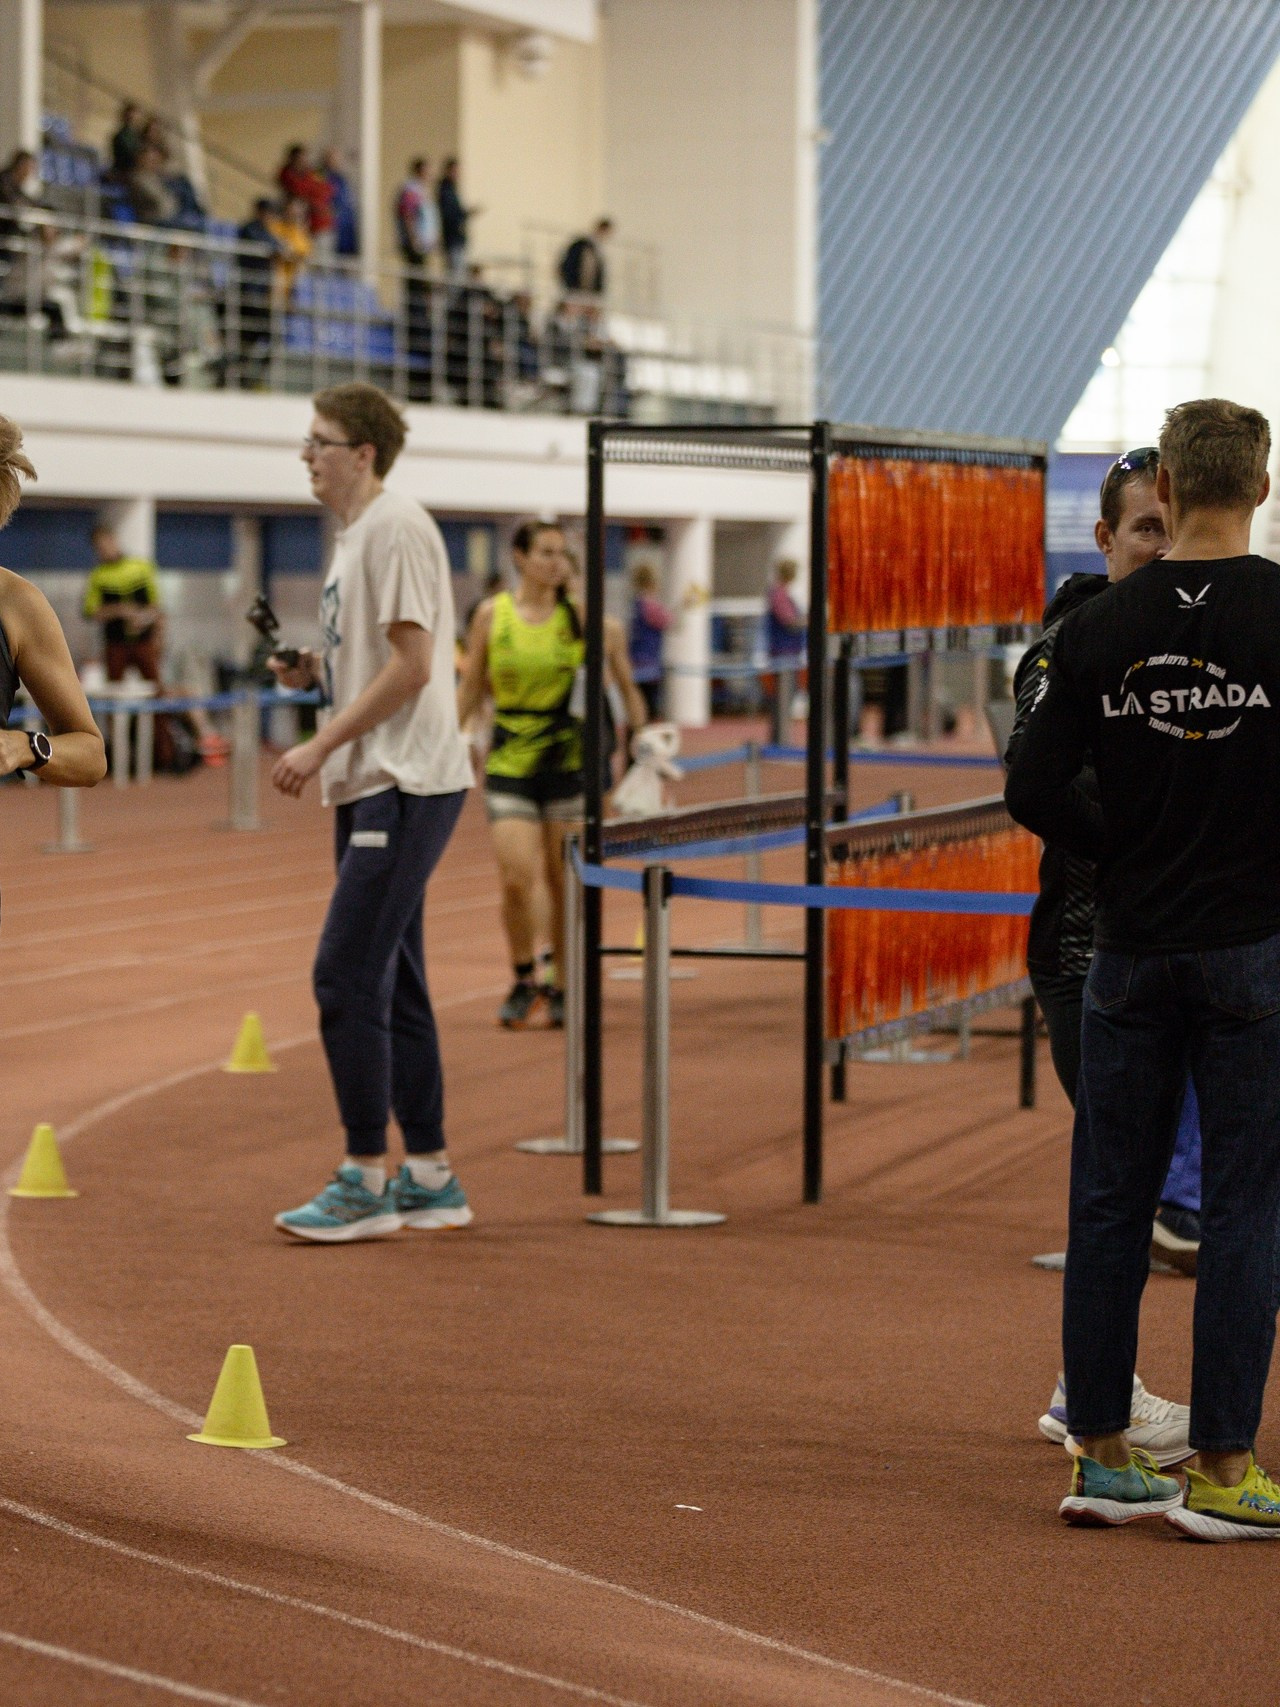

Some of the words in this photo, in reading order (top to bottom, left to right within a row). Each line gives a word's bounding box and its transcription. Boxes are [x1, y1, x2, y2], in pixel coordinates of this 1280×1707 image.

[1146, 653, 1168, 667] ТВОЙ
[1165, 654, 1189, 667] ПУТЬ
[1205, 661, 1227, 680] ТВОЙ
[1102, 691, 1145, 718] LA
[1150, 683, 1272, 714] STRADA
[1148, 716, 1171, 733] ТВОЙ
[1238, 1490, 1280, 1516] HOK
